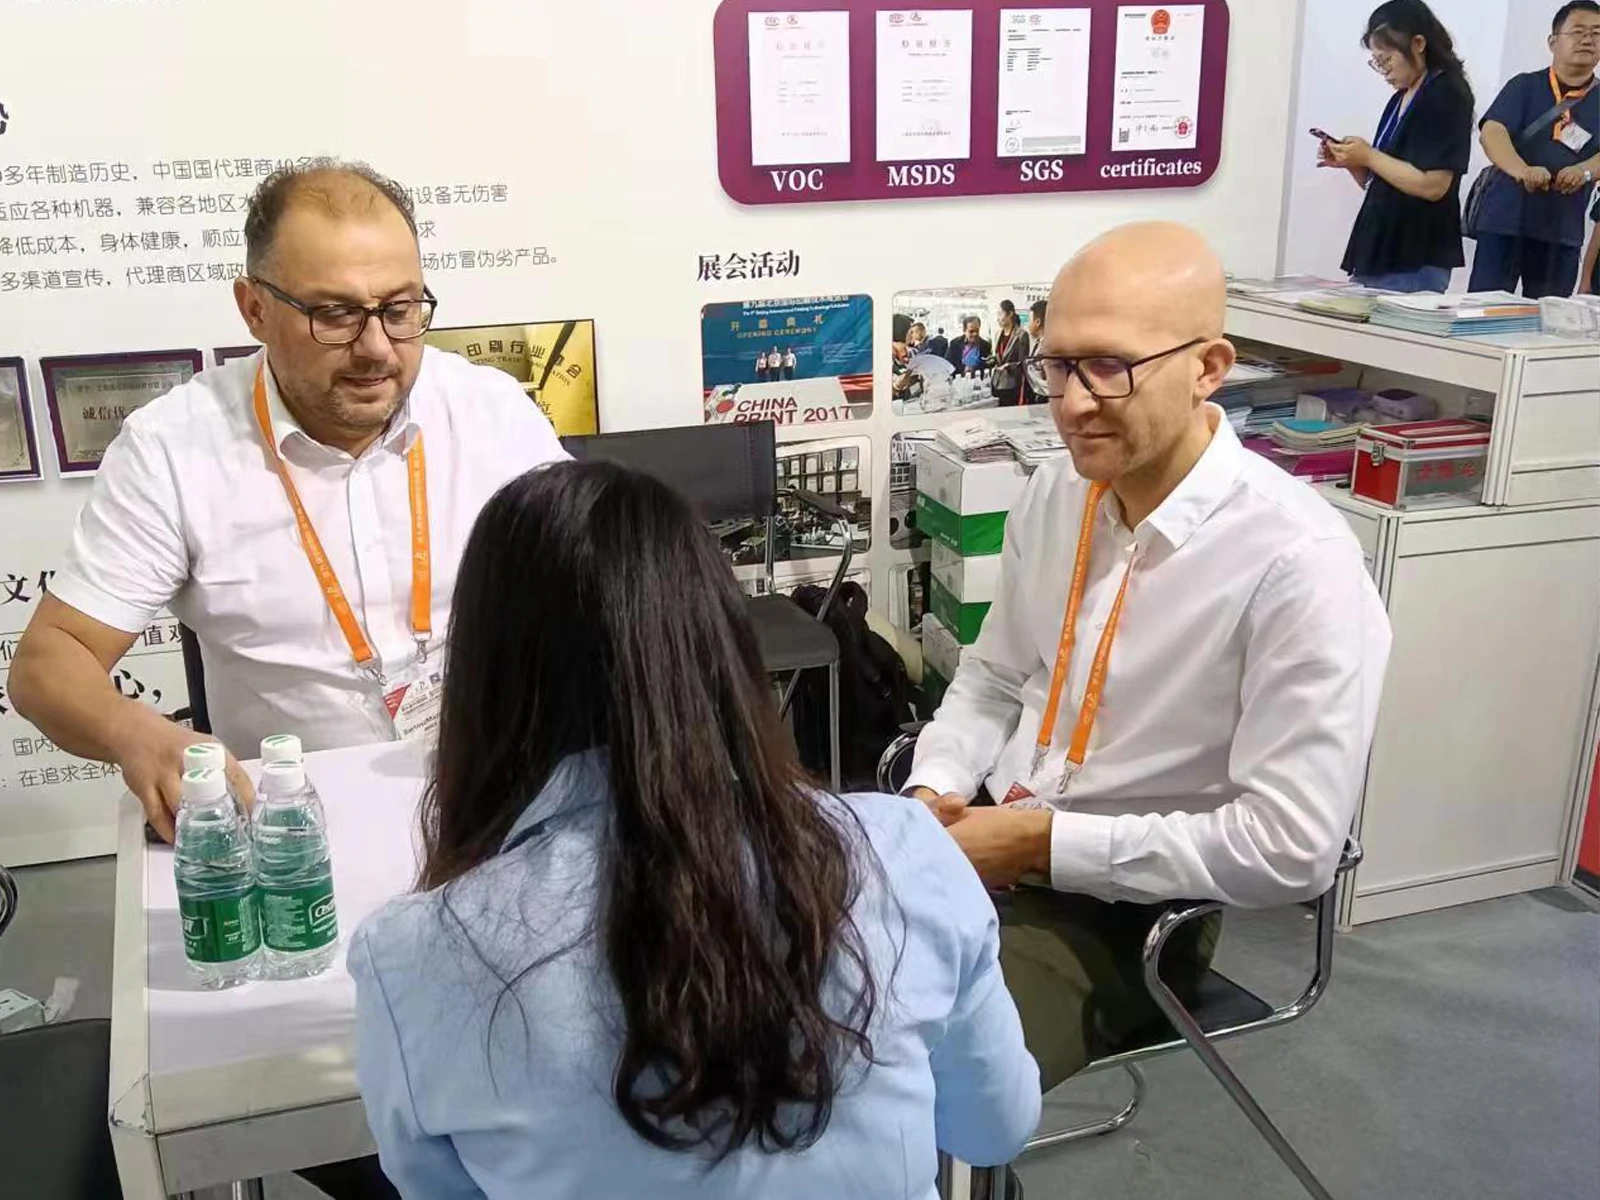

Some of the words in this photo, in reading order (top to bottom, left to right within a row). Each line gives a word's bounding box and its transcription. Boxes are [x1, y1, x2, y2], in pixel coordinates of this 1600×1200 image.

[887, 163, 955, 187] MSDS
[1020, 159, 1063, 181] SGS
[1100, 158, 1202, 179] certificates
[770, 169, 824, 191] VOC
[697, 250, 800, 282] 展会活动
[737, 397, 798, 412] CHINA
[804, 406, 852, 422] 2017
